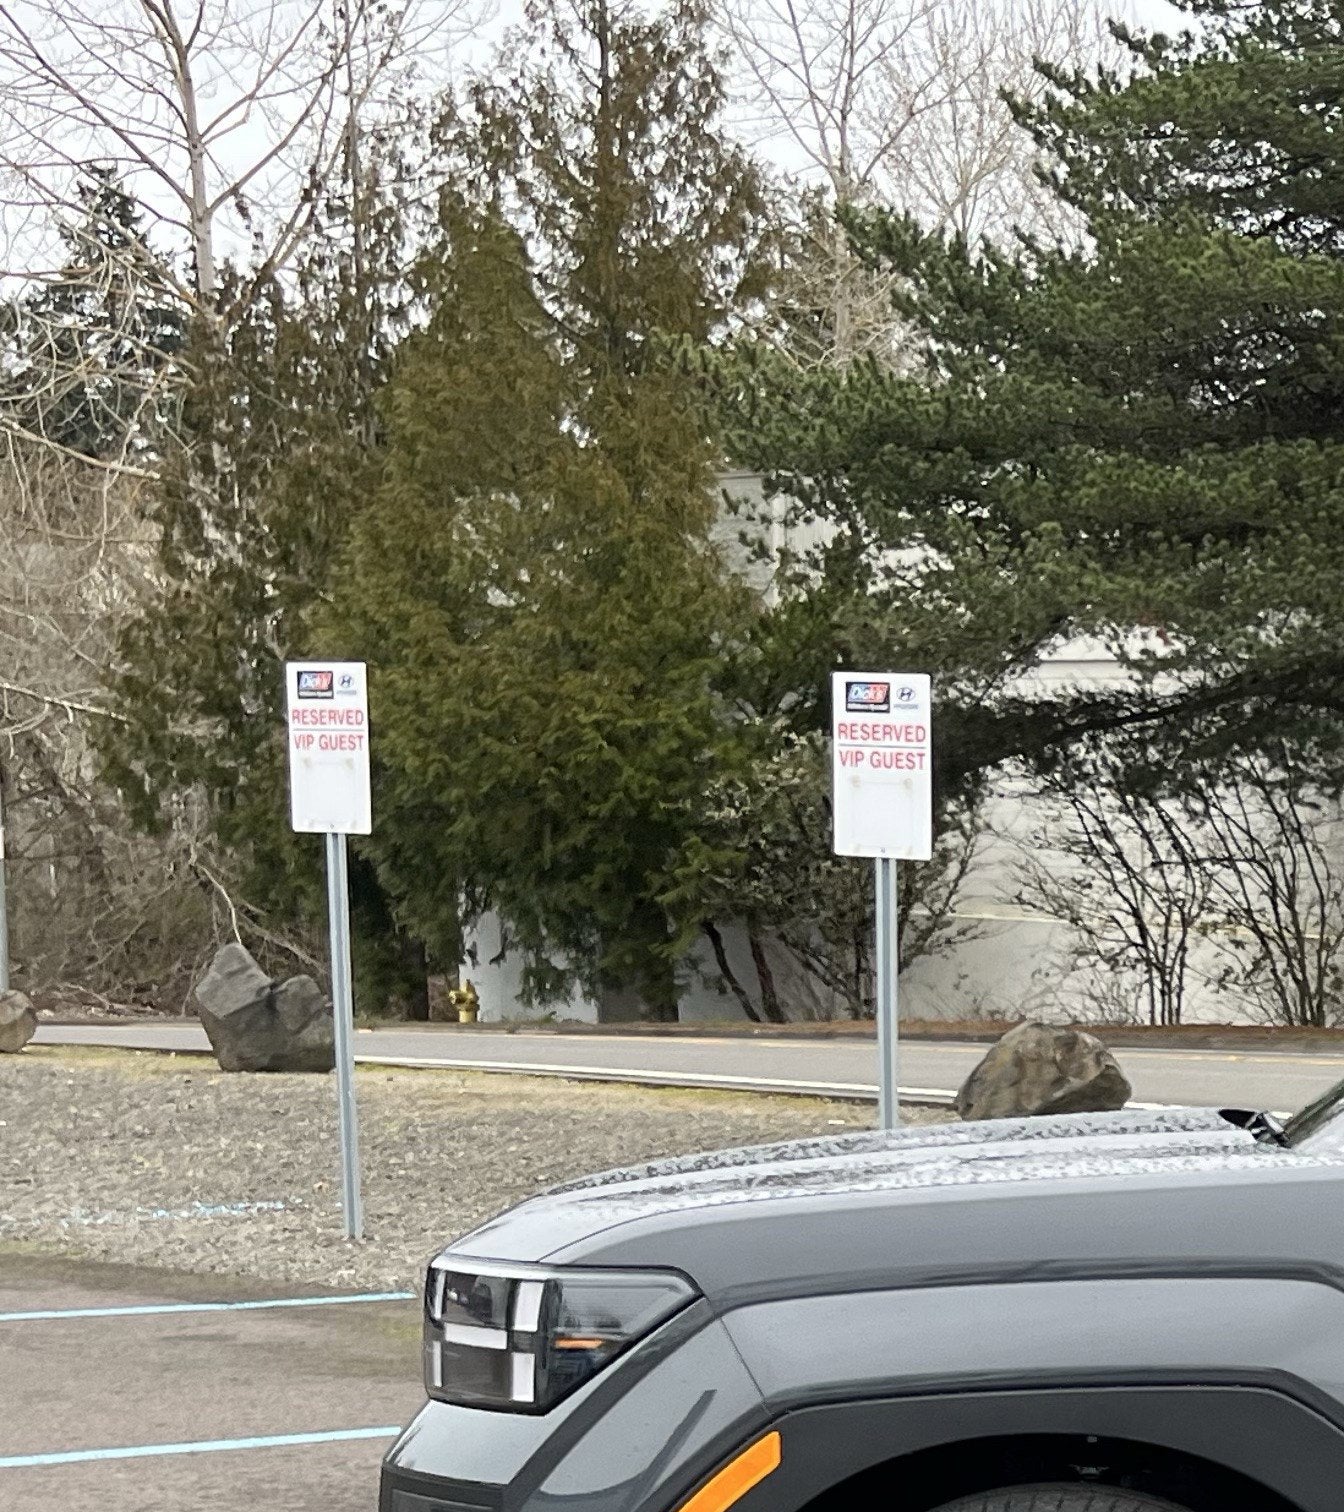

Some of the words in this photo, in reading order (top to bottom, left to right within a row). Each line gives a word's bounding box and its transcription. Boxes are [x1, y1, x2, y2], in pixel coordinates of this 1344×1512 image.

[291, 708, 364, 726] RESERVED
[837, 722, 926, 743] RESERVED
[294, 734, 315, 750] VIP
[318, 734, 364, 751] GUEST
[839, 750, 864, 767] VIP
[870, 751, 926, 770] GUEST
